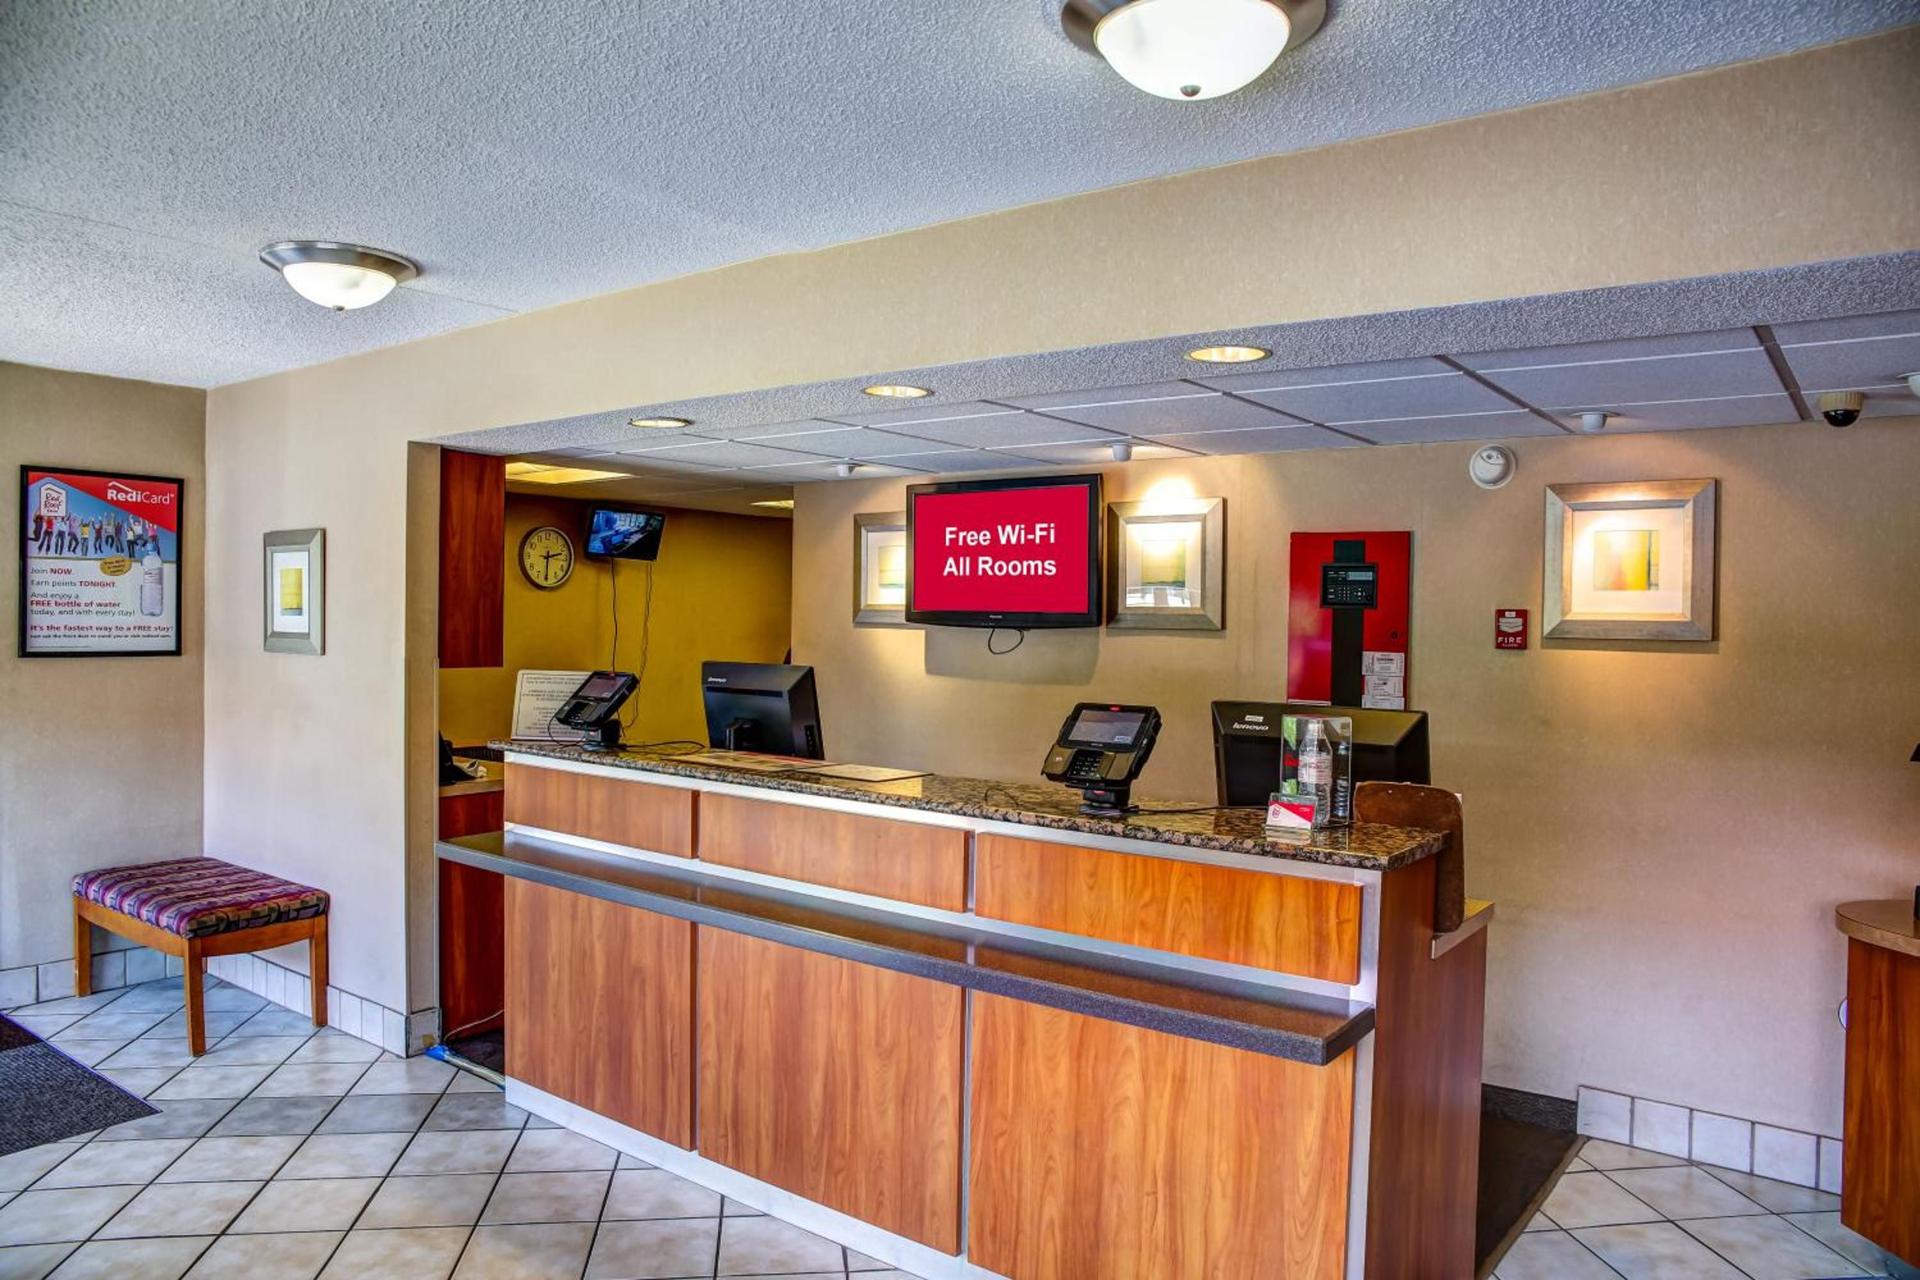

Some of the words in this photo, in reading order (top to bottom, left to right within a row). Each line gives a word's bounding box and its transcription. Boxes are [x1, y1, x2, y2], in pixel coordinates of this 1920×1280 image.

[945, 527, 991, 547] Free
[997, 523, 1056, 545] Wi-Fi
[943, 556, 970, 576] All
[978, 556, 1058, 576] Rooms
[30, 567, 48, 575] Join
[50, 567, 73, 575] NOW
[50, 592, 73, 600] enjoy
[54, 600, 82, 608] bottle
[84, 600, 94, 608] of
[95, 625, 113, 633] way
[1497, 636, 1523, 644] FIRE
[1232, 722, 1269, 731] lenovo
